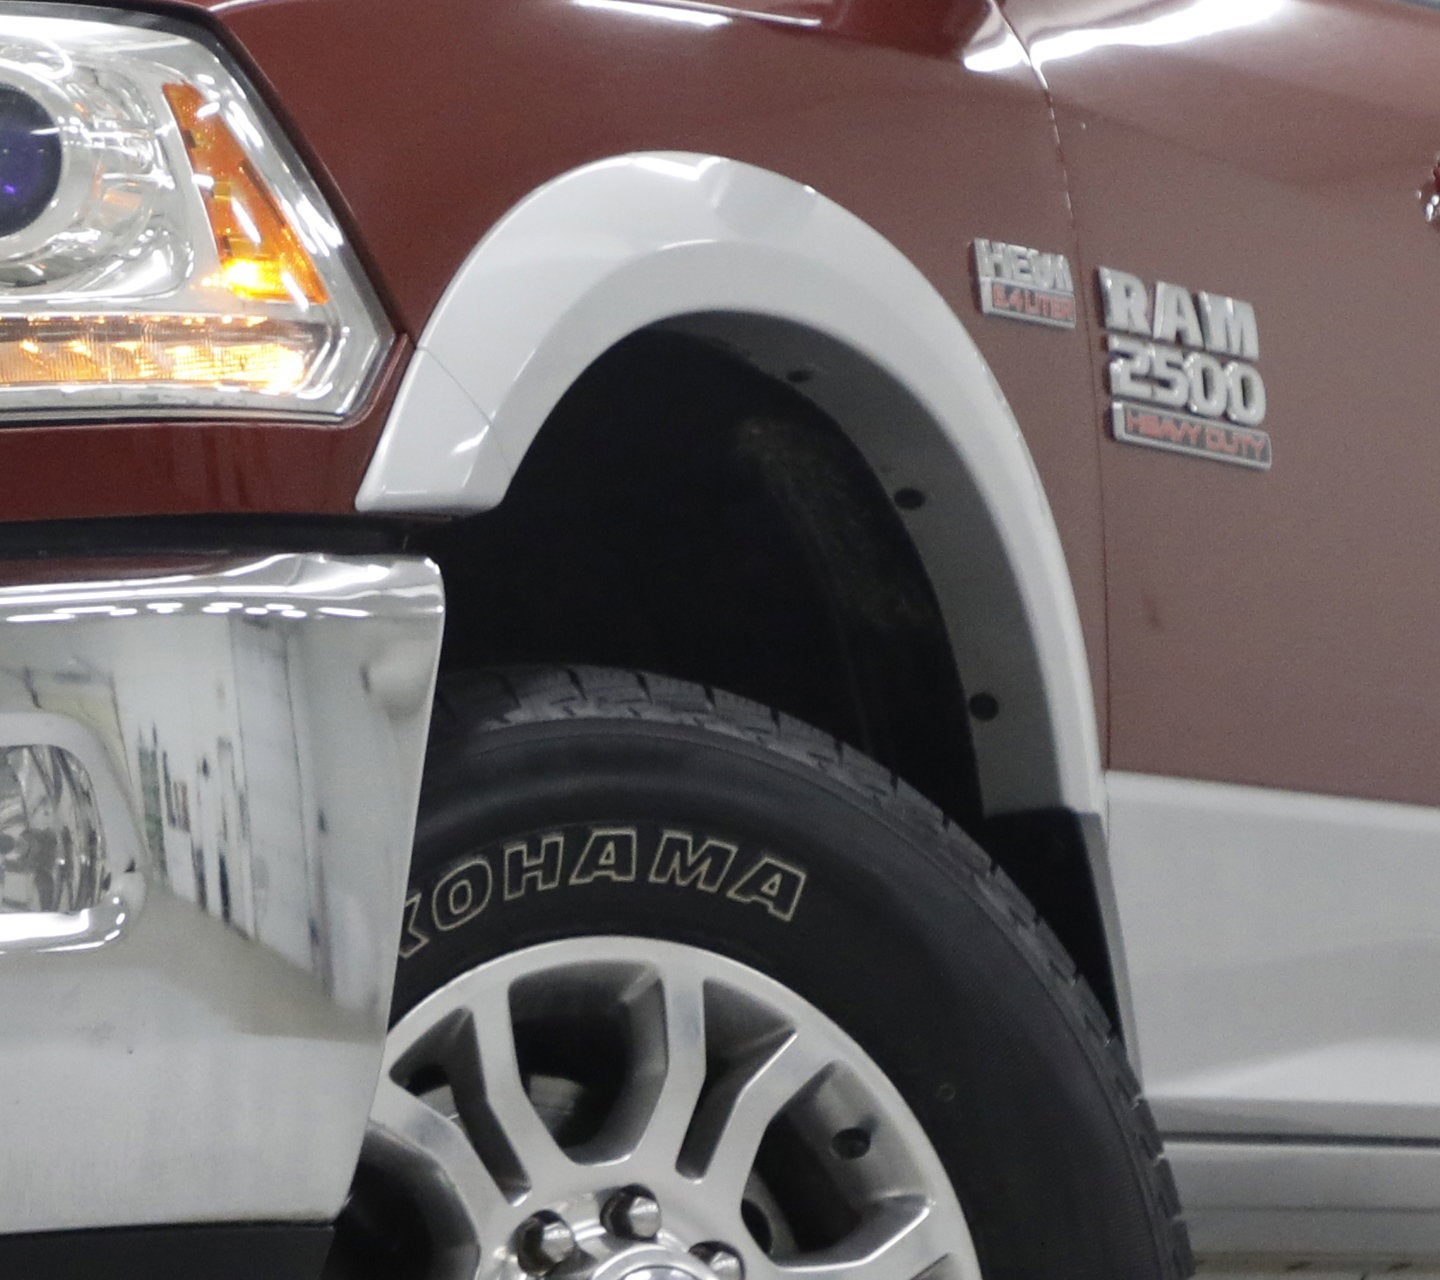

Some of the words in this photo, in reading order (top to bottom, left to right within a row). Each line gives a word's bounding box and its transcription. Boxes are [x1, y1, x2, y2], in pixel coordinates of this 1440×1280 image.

[1098, 266, 1260, 361] RAM
[1106, 333, 1267, 427] 2500
[1126, 410, 1202, 445] HEAVY
[1205, 426, 1267, 460] DUTY
